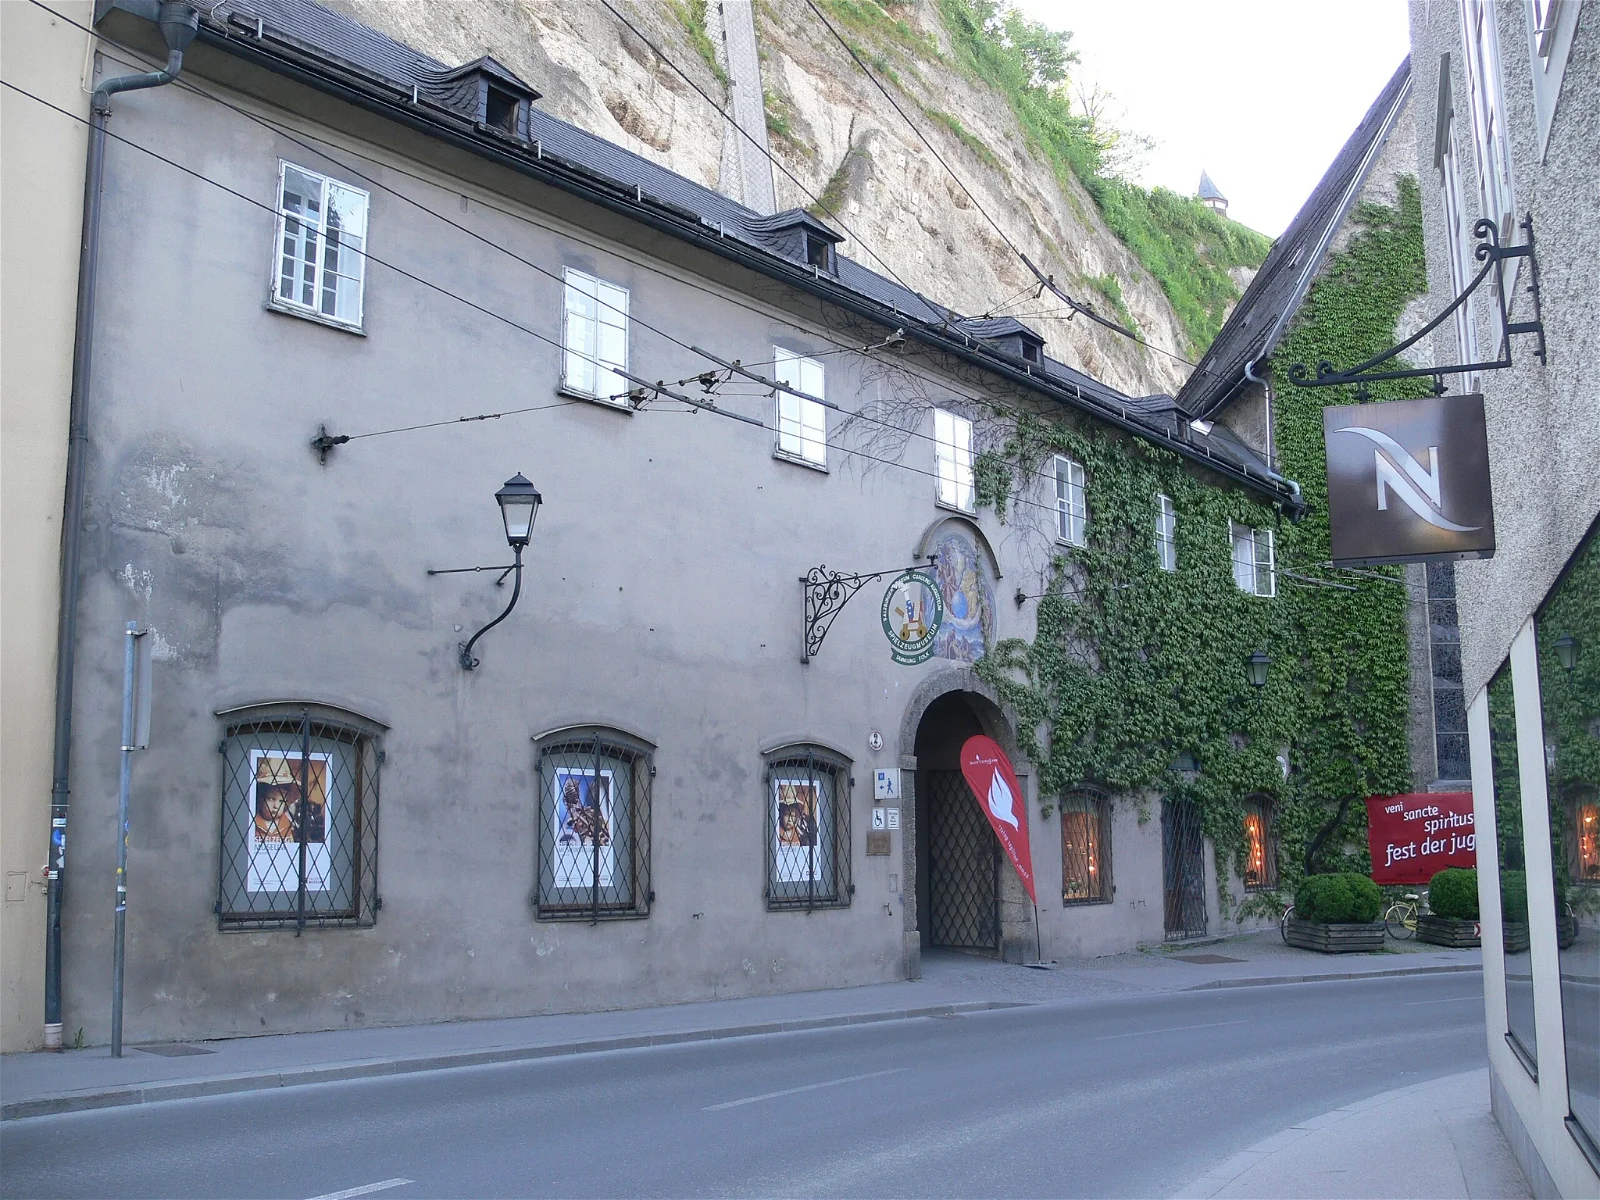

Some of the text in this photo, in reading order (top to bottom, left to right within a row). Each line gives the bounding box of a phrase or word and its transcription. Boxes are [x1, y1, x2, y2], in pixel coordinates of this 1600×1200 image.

[887, 623, 938, 650] SPIELZEUGMUSEUM
[918, 651, 930, 661] FOLK
[1385, 801, 1404, 813] veni
[1403, 805, 1439, 821] sancte
[1424, 811, 1474, 834] spiritus
[1385, 833, 1475, 866] fest der jug
